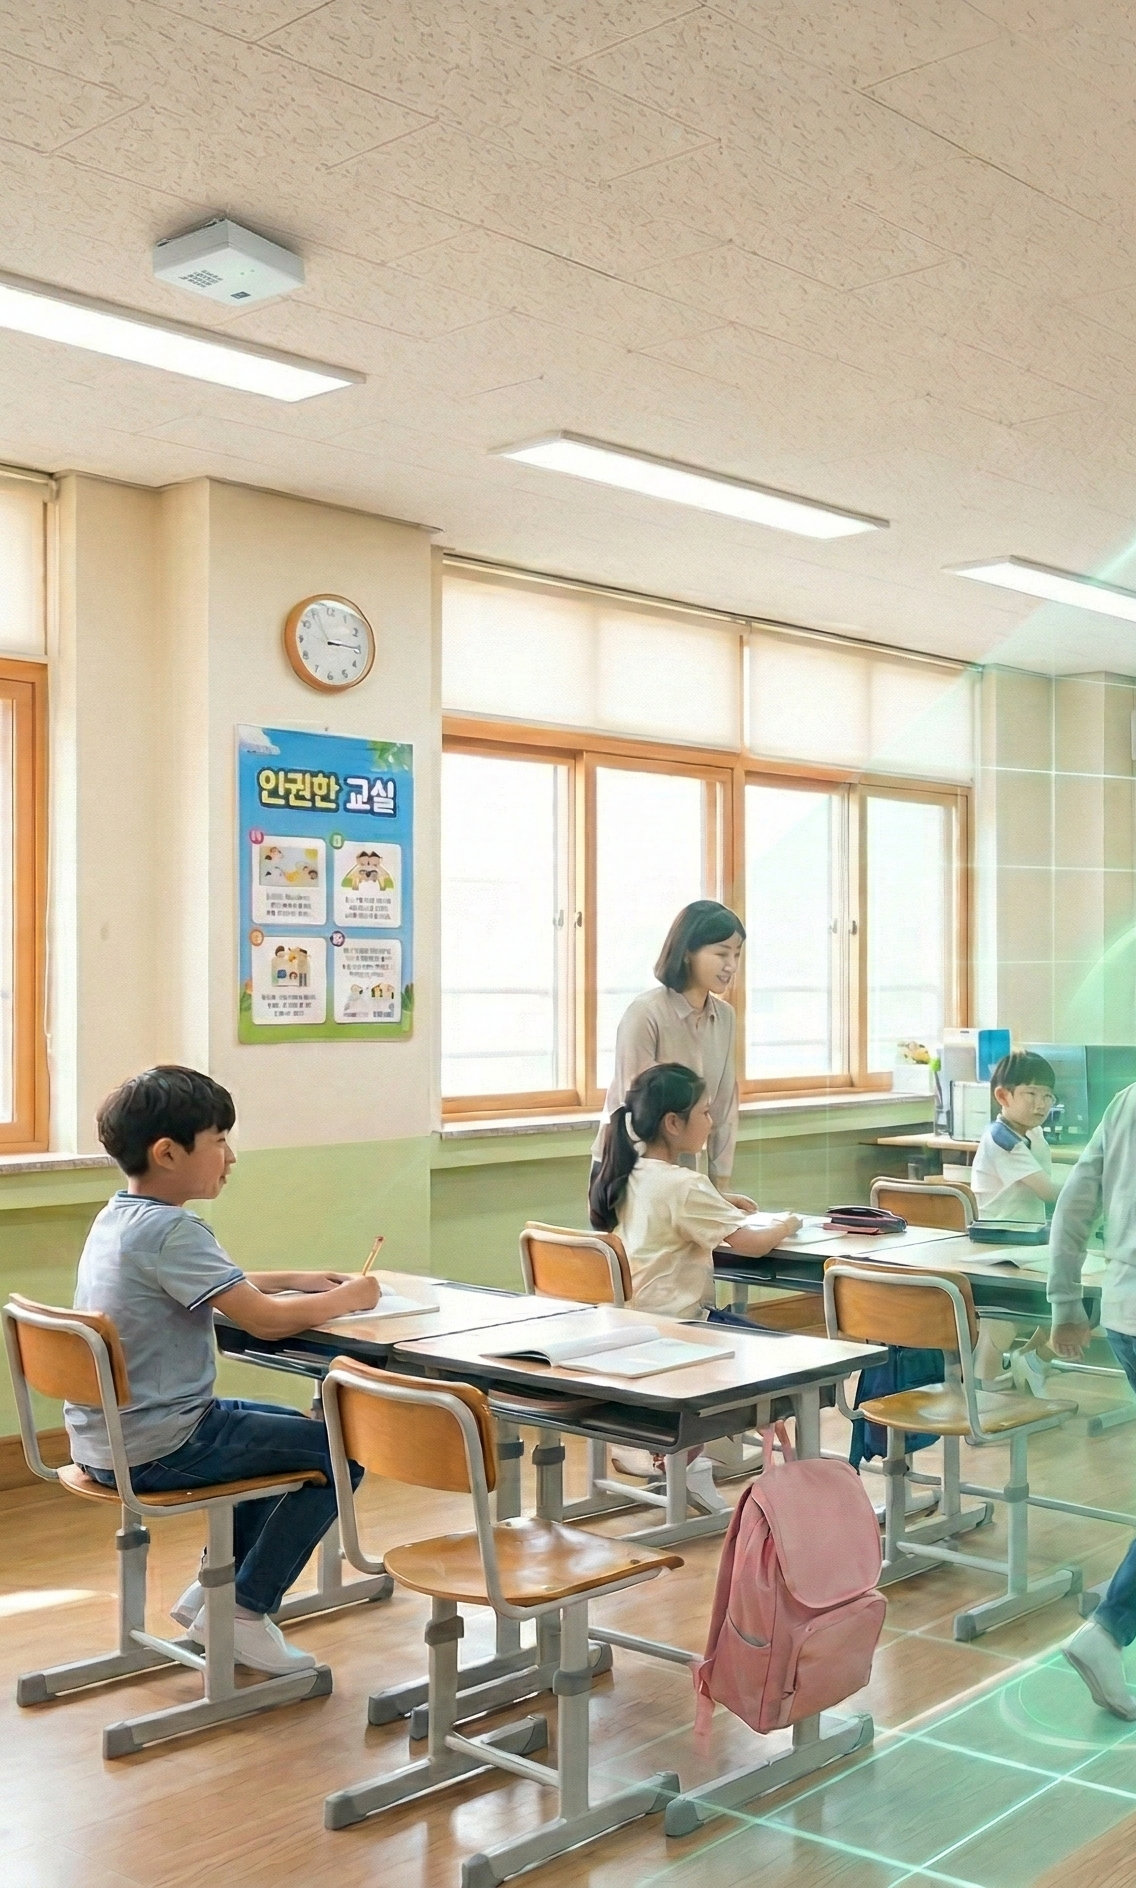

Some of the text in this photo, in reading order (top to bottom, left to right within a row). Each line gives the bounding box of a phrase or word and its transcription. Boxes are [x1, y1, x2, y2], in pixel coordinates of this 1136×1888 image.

[352, 627, 359, 638] 2
[327, 671, 334, 681] 6
[258, 769, 395, 815] 인권한 교실
